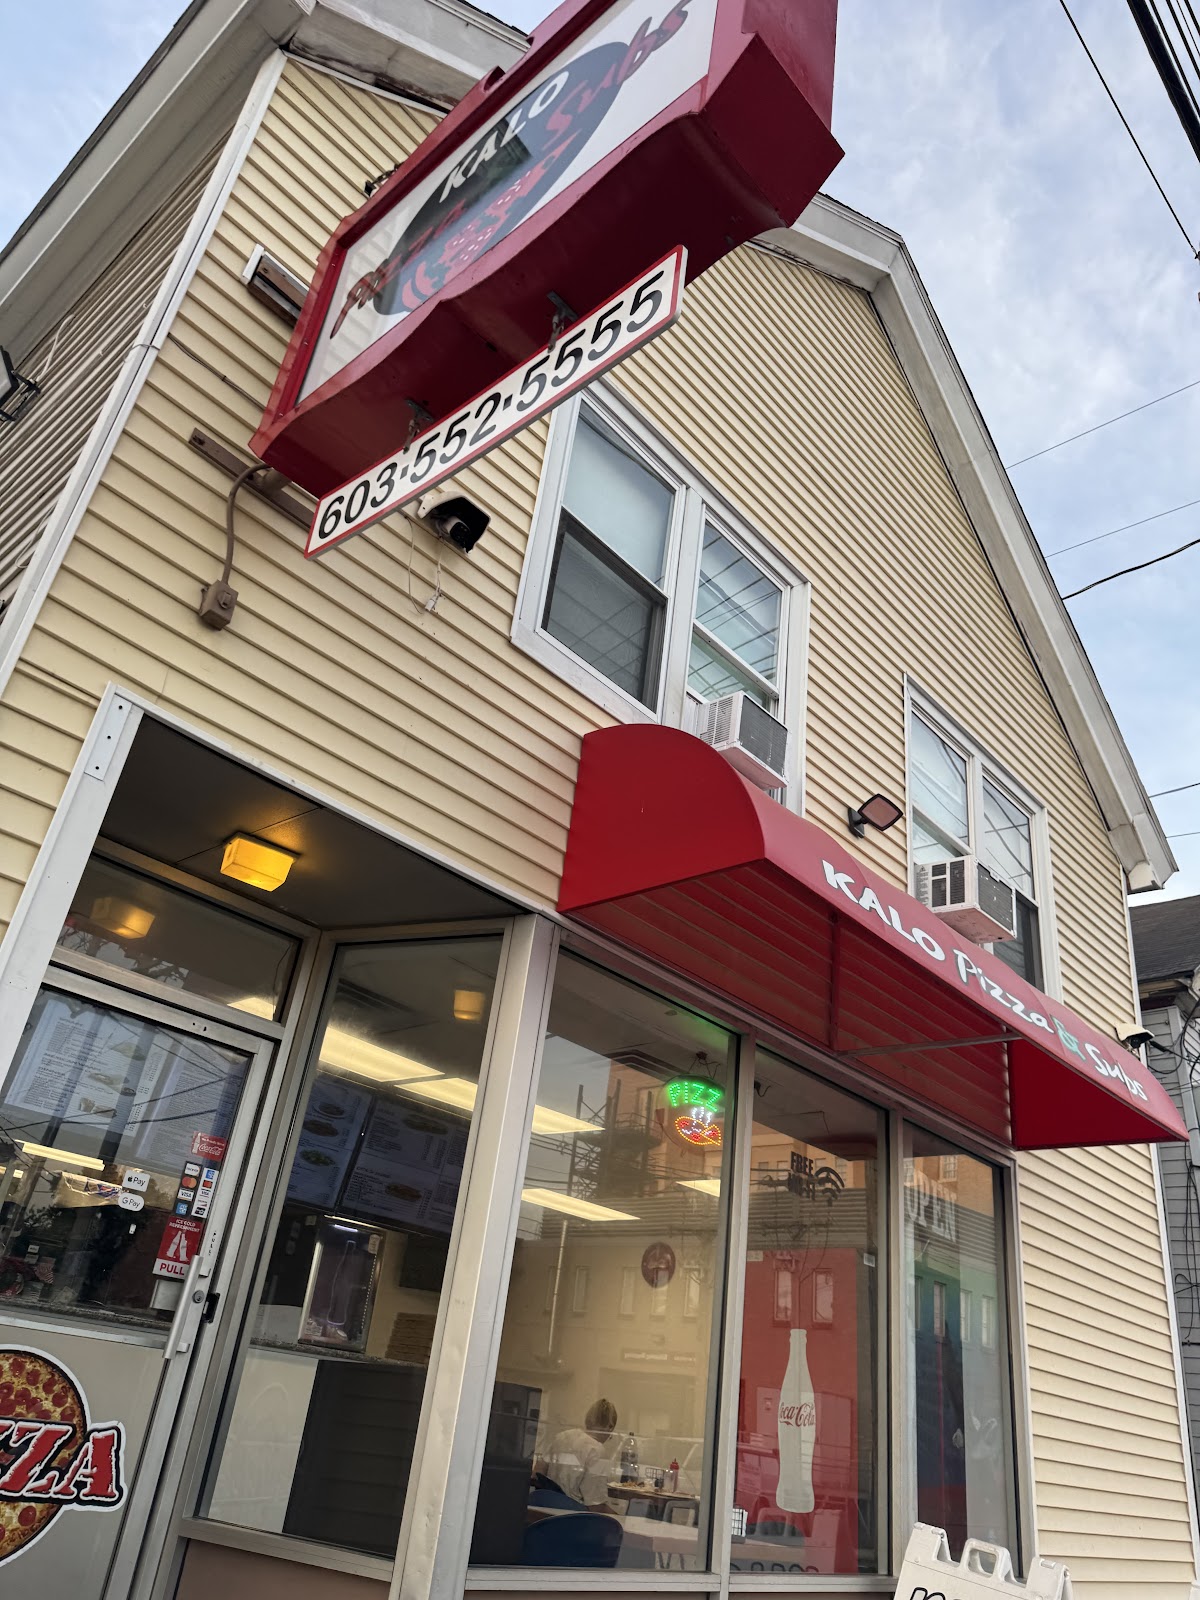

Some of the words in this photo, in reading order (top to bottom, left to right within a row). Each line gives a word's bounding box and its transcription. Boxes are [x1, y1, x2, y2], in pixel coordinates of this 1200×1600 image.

[439, 70, 570, 203] KALO
[822, 859, 946, 961] KALO
[953, 949, 1055, 1034] Pizza
[1084, 1042, 1149, 1101] Subs
[669, 1081, 722, 1113] PIZZ
[133, 1176, 146, 1187] Pay
[129, 1198, 141, 1209] Pay
[159, 1262, 185, 1276] PULL
[0, 1421, 120, 1501] ZA
